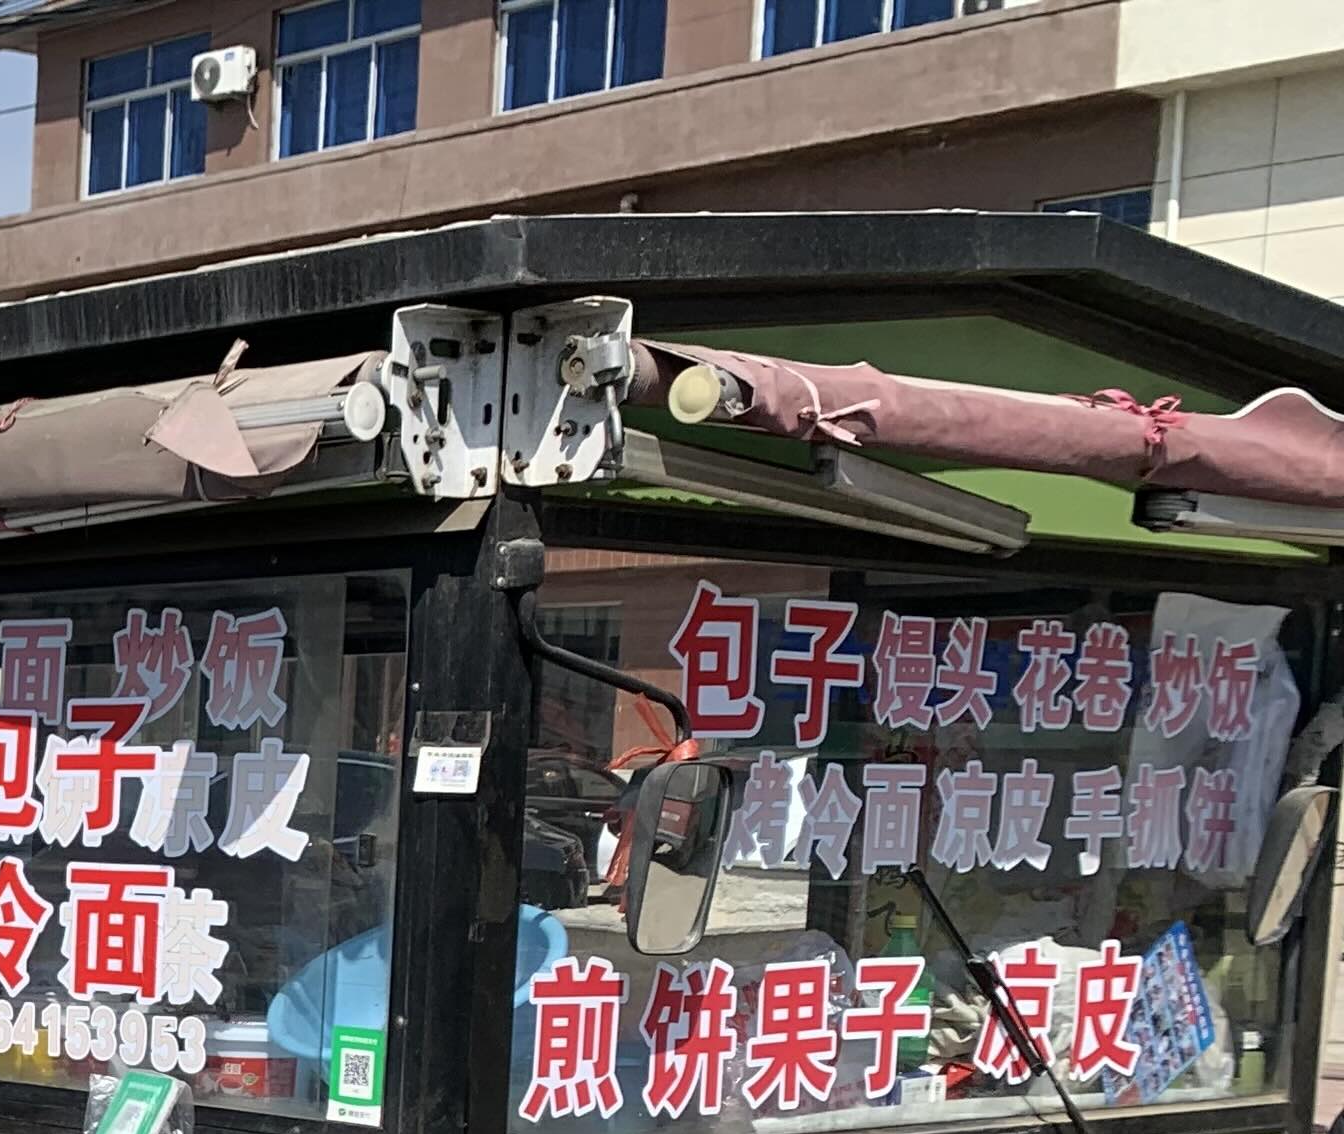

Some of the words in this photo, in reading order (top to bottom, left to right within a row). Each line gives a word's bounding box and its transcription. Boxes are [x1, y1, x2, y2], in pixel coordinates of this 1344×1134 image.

[113, 608, 287, 729] 炒饭
[670, 580, 864, 747] 包子
[873, 610, 997, 731] 馒头
[1013, 620, 1132, 732] 花卷
[1148, 633, 1260, 740] 炒饭
[723, 750, 927, 880] 烤冷面
[932, 759, 1054, 873] 凉皮
[1066, 762, 1237, 877] 手抓饼
[519, 956, 931, 1122] 煎饼果子
[975, 938, 1144, 1083] 凉皮
